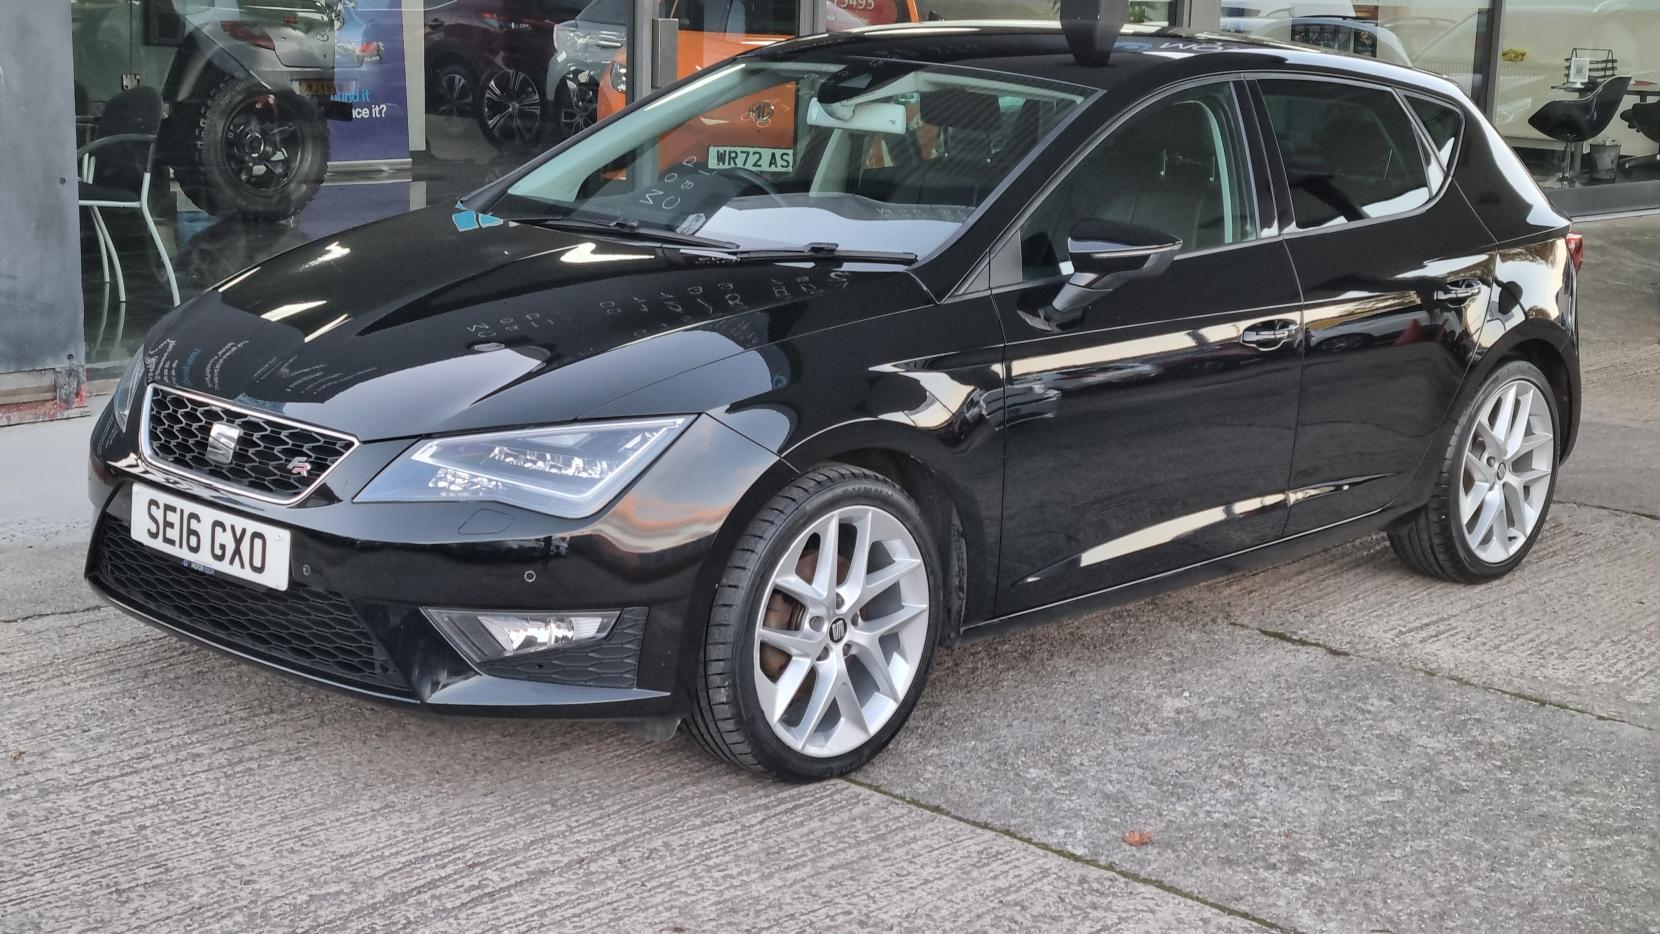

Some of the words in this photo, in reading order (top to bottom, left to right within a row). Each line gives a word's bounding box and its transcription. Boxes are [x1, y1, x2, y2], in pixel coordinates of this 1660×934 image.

[372, 104, 387, 118] it?
[716, 150, 763, 168] WR72
[146, 498, 202, 554] SE16
[210, 519, 267, 575] GXO
